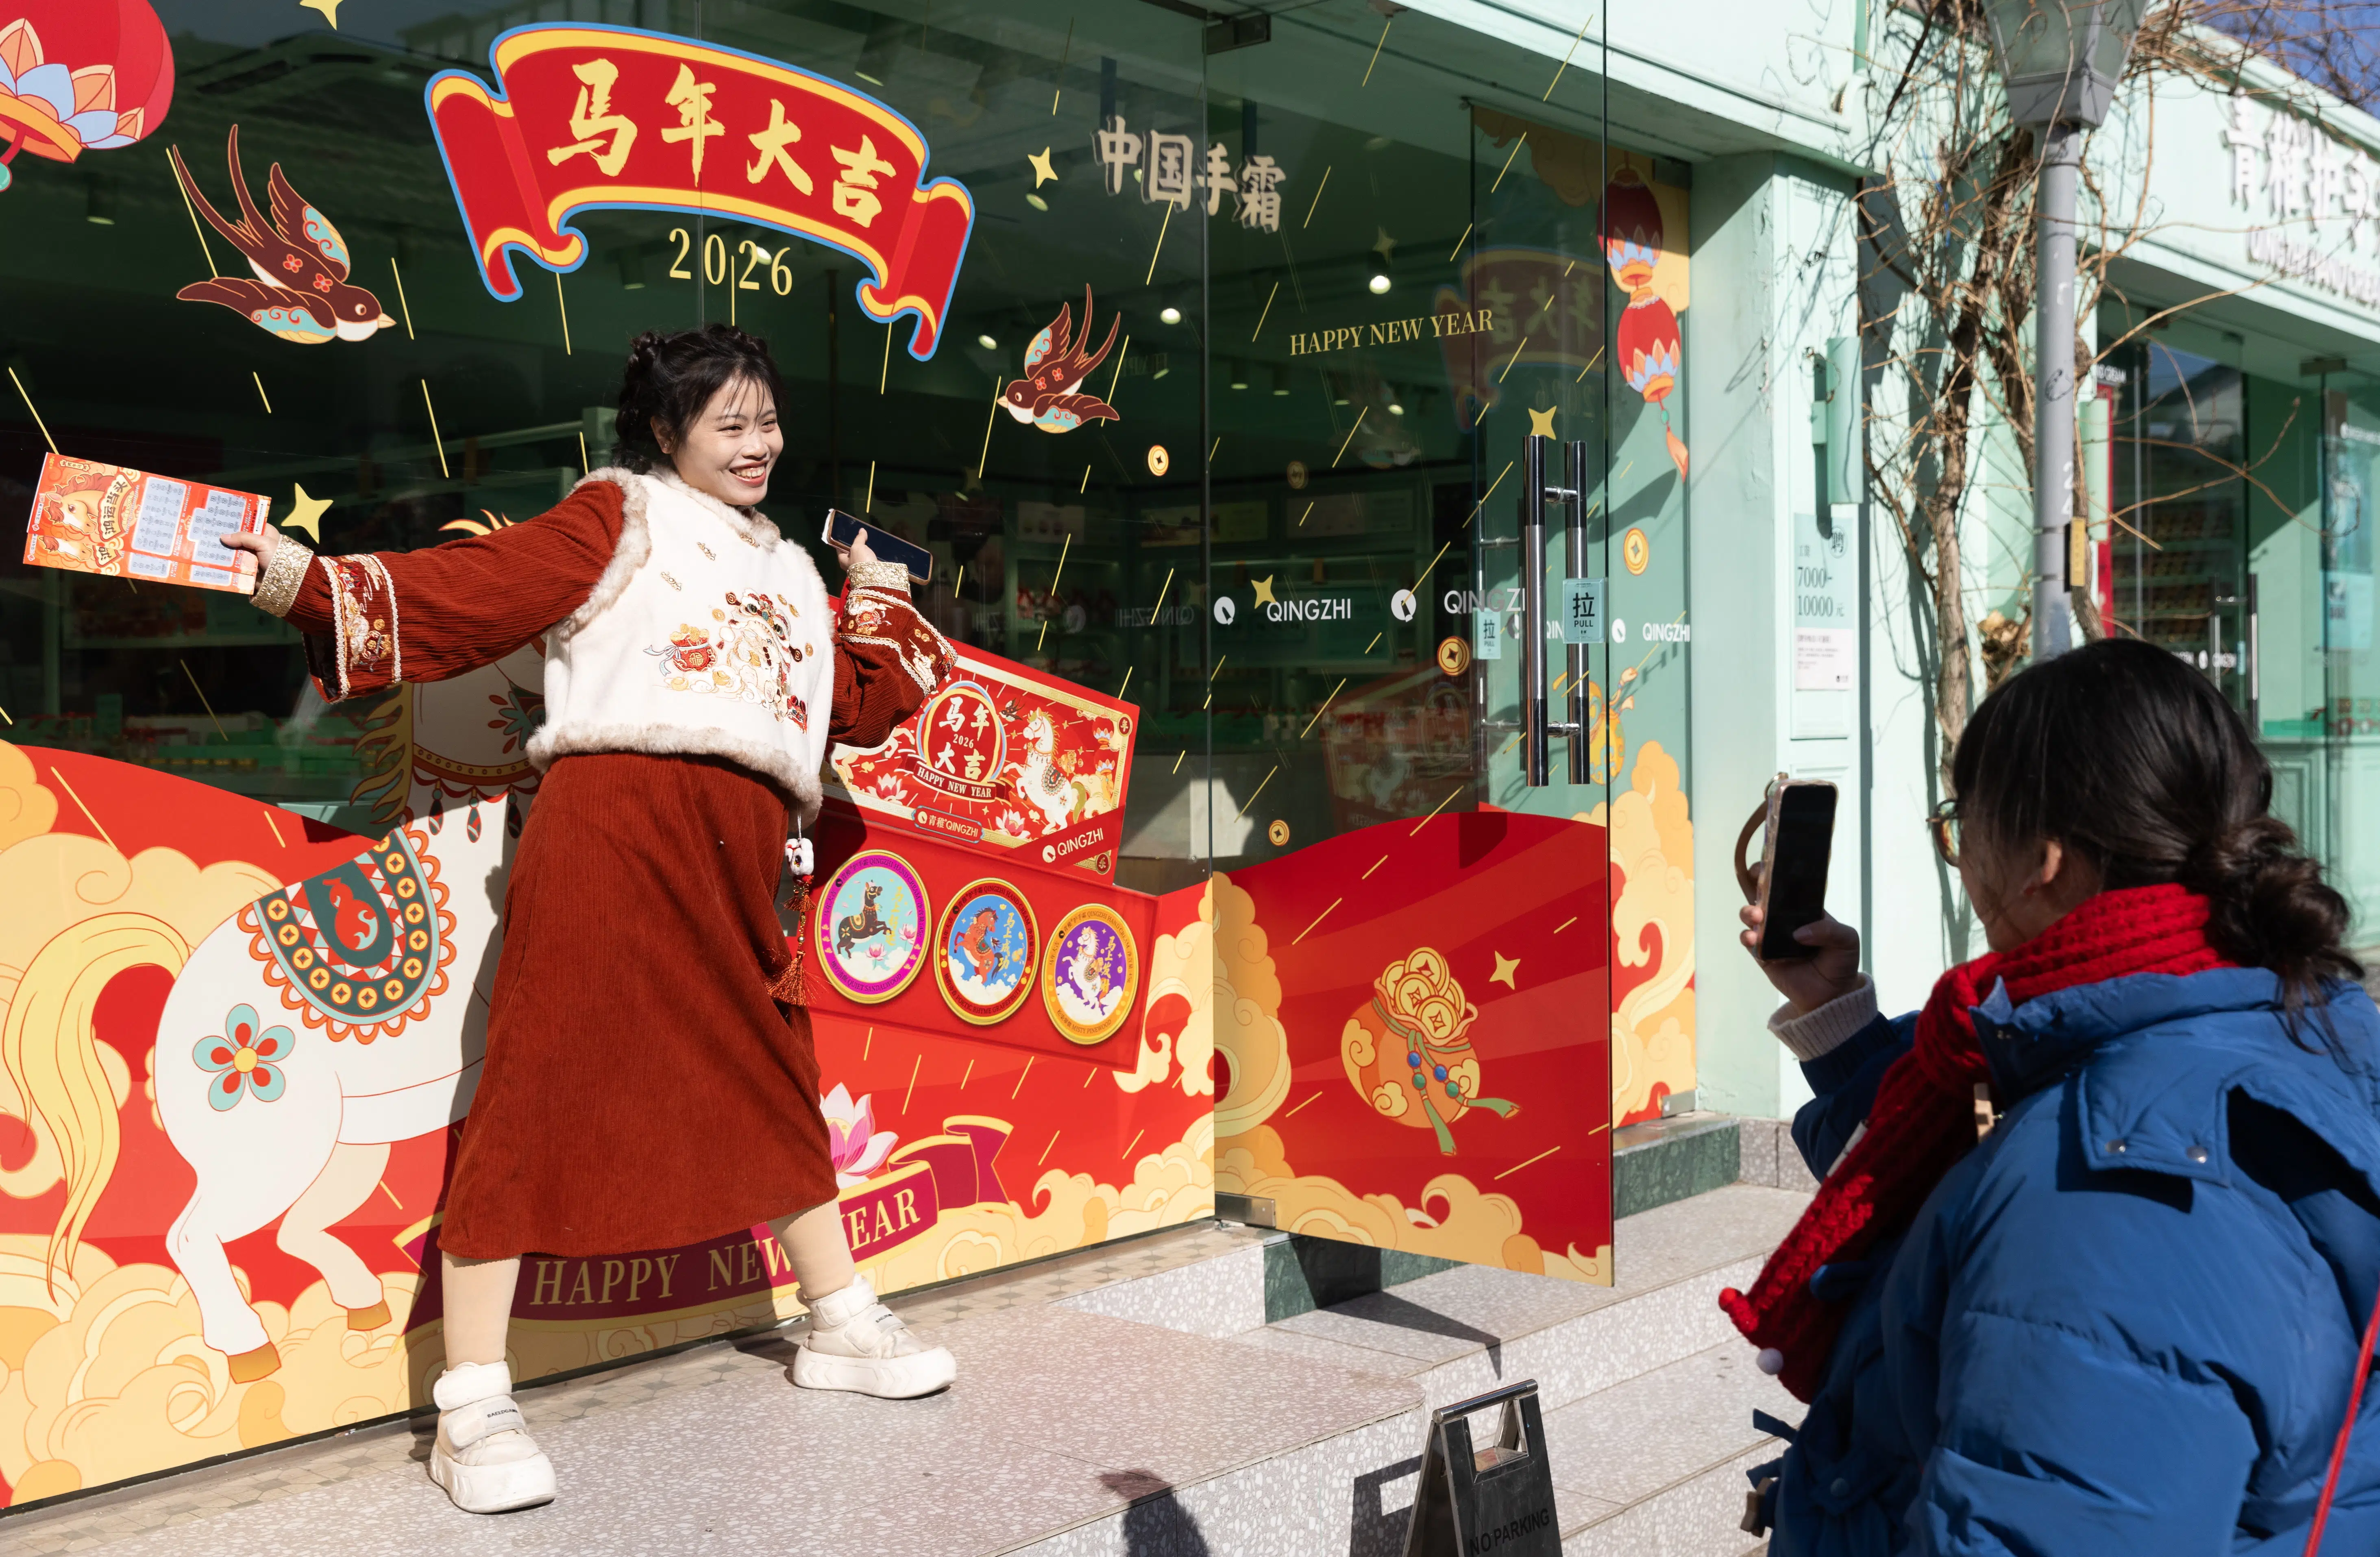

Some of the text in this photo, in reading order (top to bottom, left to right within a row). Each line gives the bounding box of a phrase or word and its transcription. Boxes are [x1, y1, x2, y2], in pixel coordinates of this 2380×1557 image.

[547, 58, 896, 228] 马年大吉
[1091, 115, 1286, 233] 中国手霜
[669, 228, 793, 295] 2026
[1290, 308, 1494, 356] HAPPY NEW YEAR
[103, 481, 128, 536] 鸿运当头
[1831, 532, 1845, 553] 聘
[1267, 598, 1351, 622] QINGZHI
[1572, 592, 1595, 618] 拉
[1798, 595, 1845, 617] 10000 元
[1483, 619, 1496, 639] 拉
[1642, 622, 1690, 642] QINGZHI
[939, 696, 990, 741] 马年
[953, 733, 974, 749] 2026
[935, 741, 986, 780] 大吉
[917, 766, 992, 798] HAPPY NEW YEAR
[945, 820, 979, 837] QINGZHI
[1058, 827, 1104, 856] QINGZHI
[869, 857, 893, 868] QINGZHI
[894, 863, 908, 879] HAND
[907, 876, 921, 900] CREAM
[983, 885, 1006, 894] QINGZHI
[1006, 890, 1020, 905] HAND
[1018, 903, 1030, 925] CREAM
[997, 912, 1015, 972] 马上成功
[1087, 911, 1108, 920] QINGZHI
[1107, 915, 1120, 930] HAND
[1119, 927, 1130, 949] CREAM
[847, 973, 902, 992] QUIET SANDALWOOD
[956, 995, 972, 1012] POETIC
[1071, 1019, 1112, 1034] MISTY PINEWOOD
[529, 1254, 680, 1306] HAPPY
[840, 1187, 922, 1252] EAR
[1469, 1508, 1550, 1557] NO PARKING
